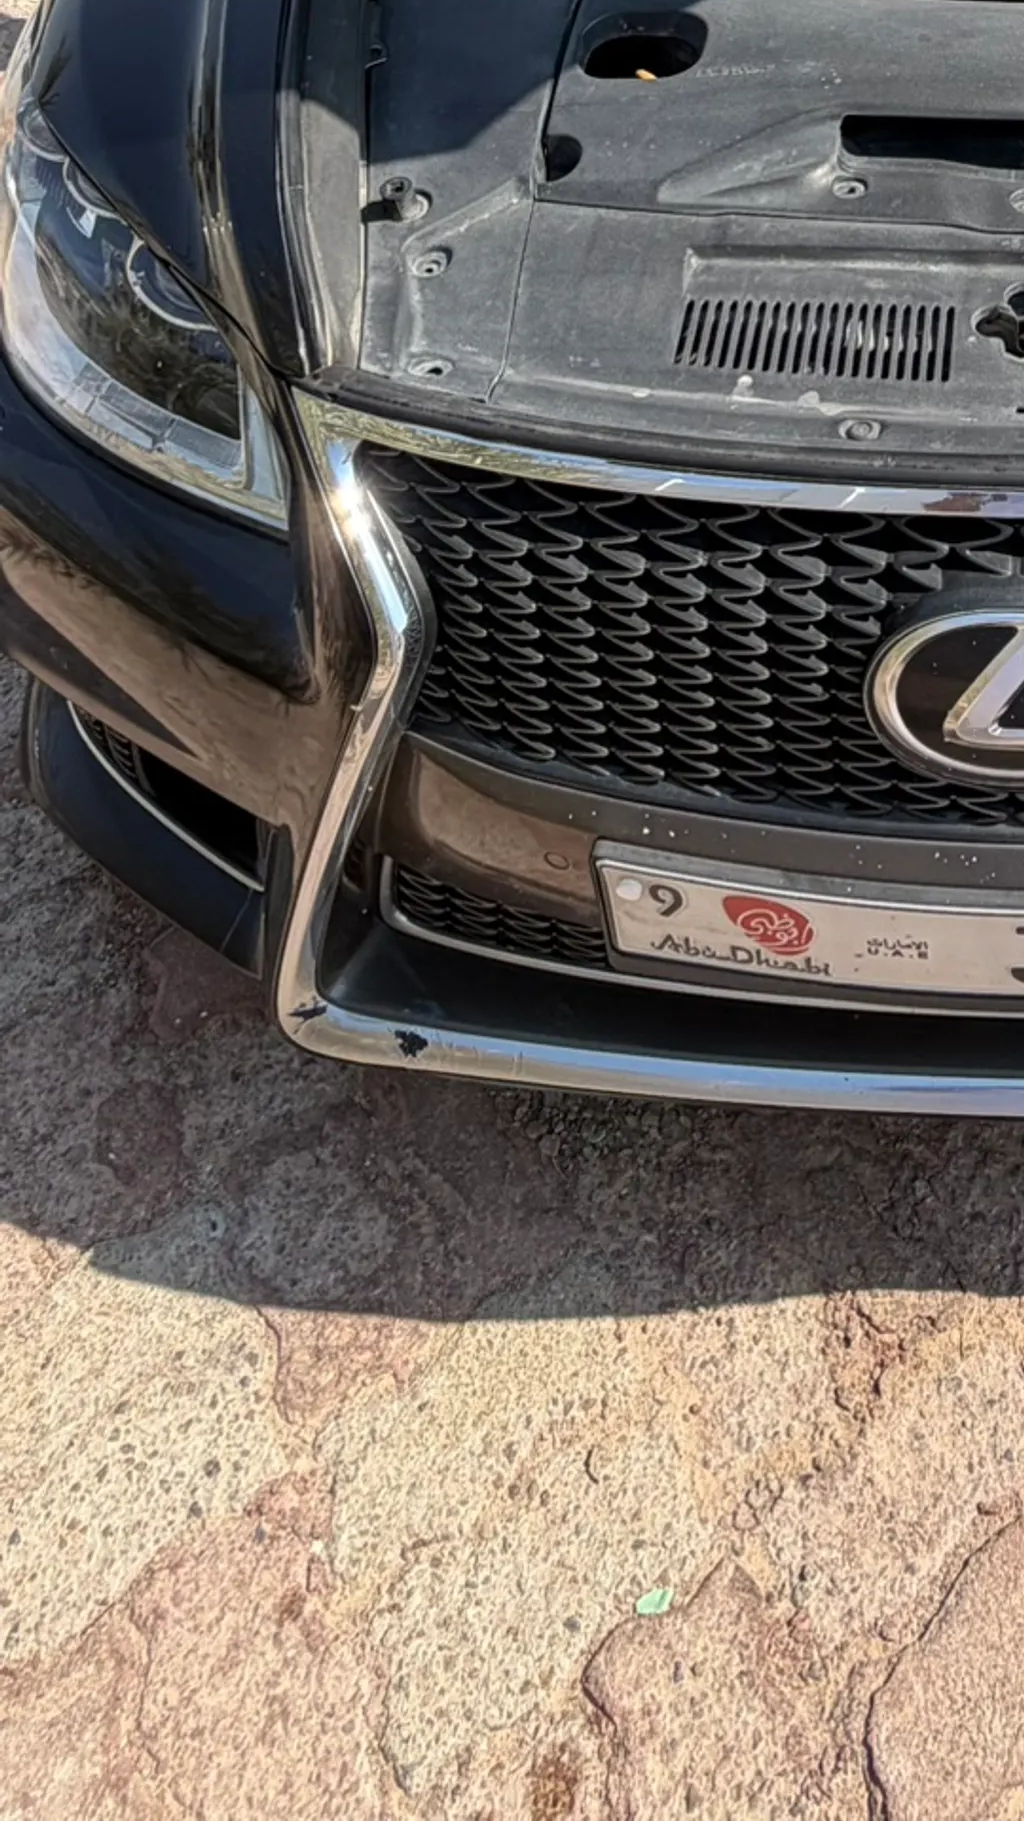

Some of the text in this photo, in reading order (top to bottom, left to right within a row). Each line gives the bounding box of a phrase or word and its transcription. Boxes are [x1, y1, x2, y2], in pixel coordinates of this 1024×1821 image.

[649, 884, 684, 918] 9
[650, 933, 832, 977] Abu Dhabi
